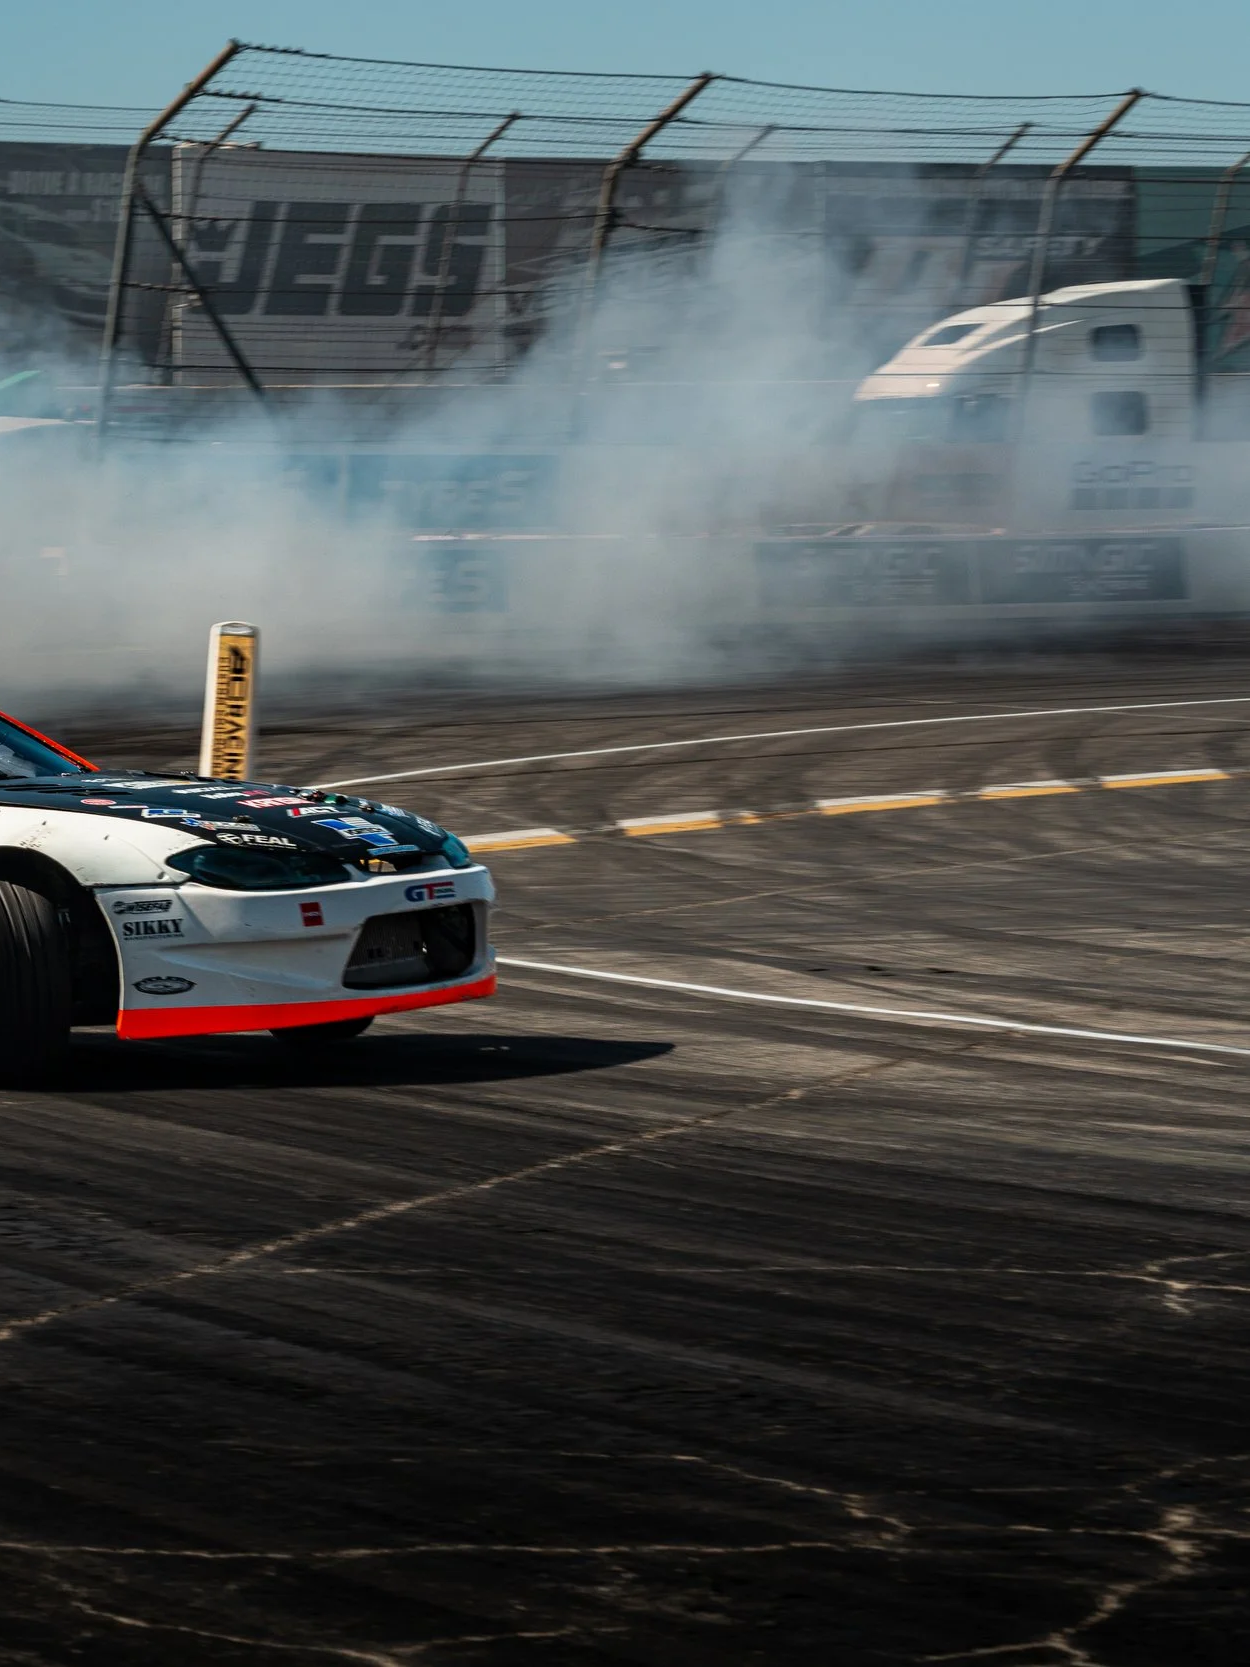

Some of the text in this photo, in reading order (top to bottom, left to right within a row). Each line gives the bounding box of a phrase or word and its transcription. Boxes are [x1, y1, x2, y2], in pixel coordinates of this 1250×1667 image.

[180, 201, 492, 316] JEGS
[241, 834, 298, 847] FEAL
[122, 918, 184, 936] SIKKY
